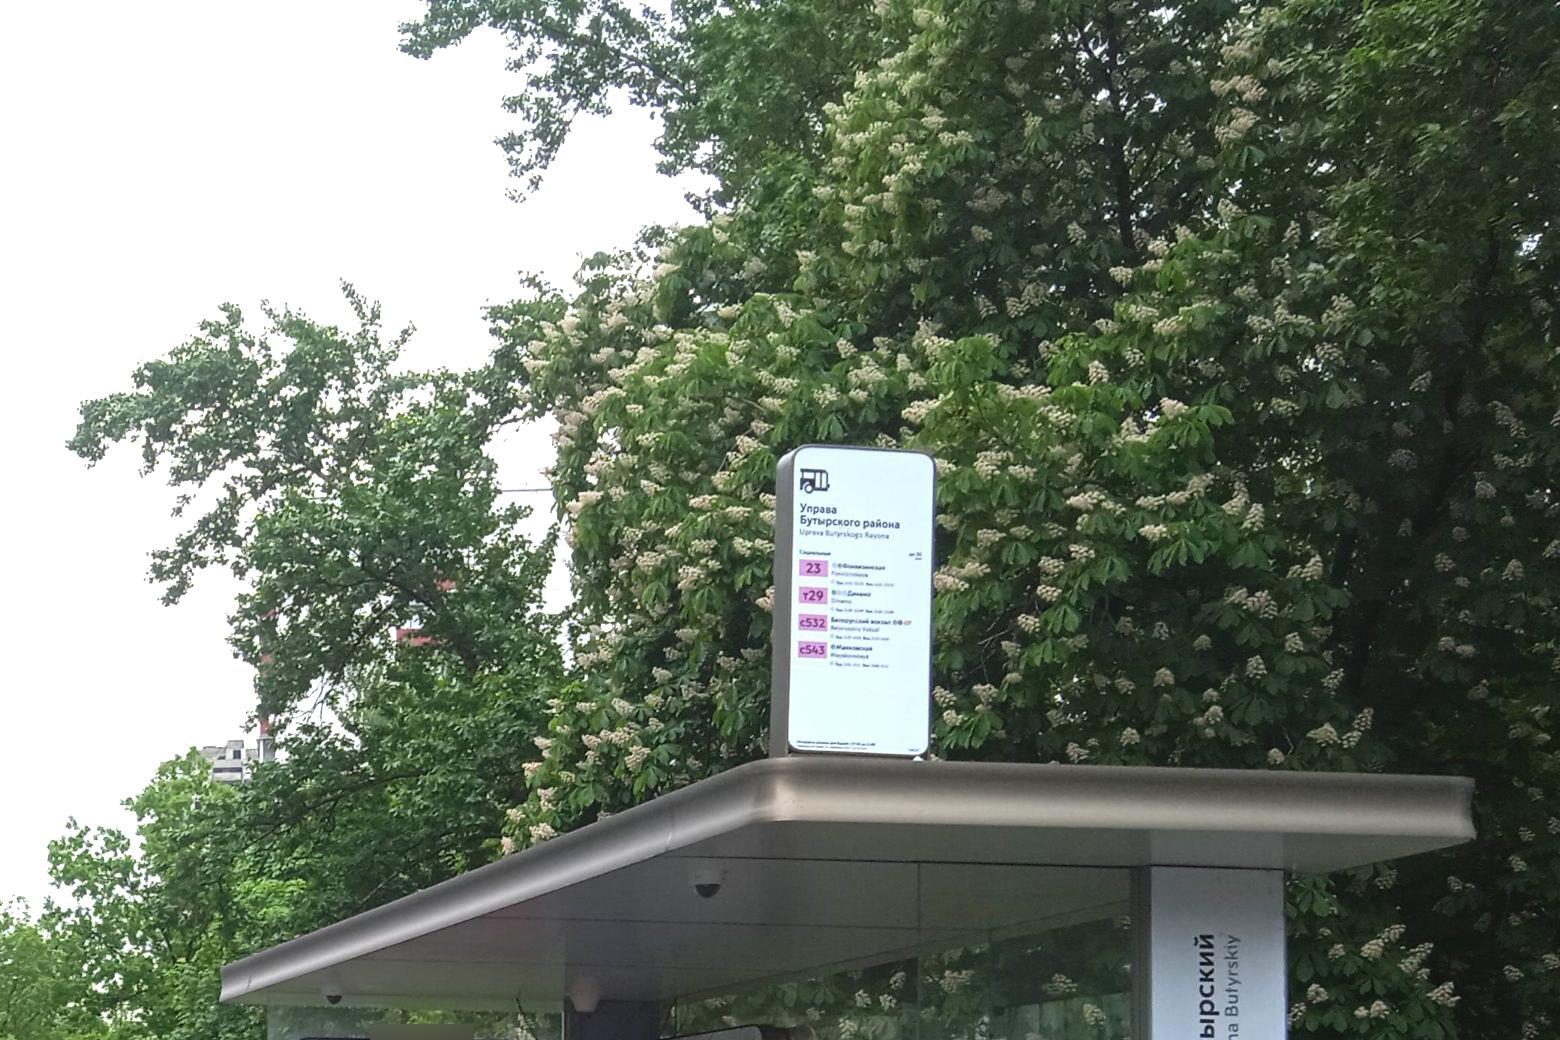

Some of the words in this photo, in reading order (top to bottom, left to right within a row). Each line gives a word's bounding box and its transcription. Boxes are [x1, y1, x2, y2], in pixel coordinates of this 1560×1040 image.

[799, 502, 838, 515] Управа
[799, 515, 861, 527] Бутырского
[863, 518, 901, 530] района
[806, 562, 822, 575] 23
[1224, 934, 1242, 1017] Butyrskiy
